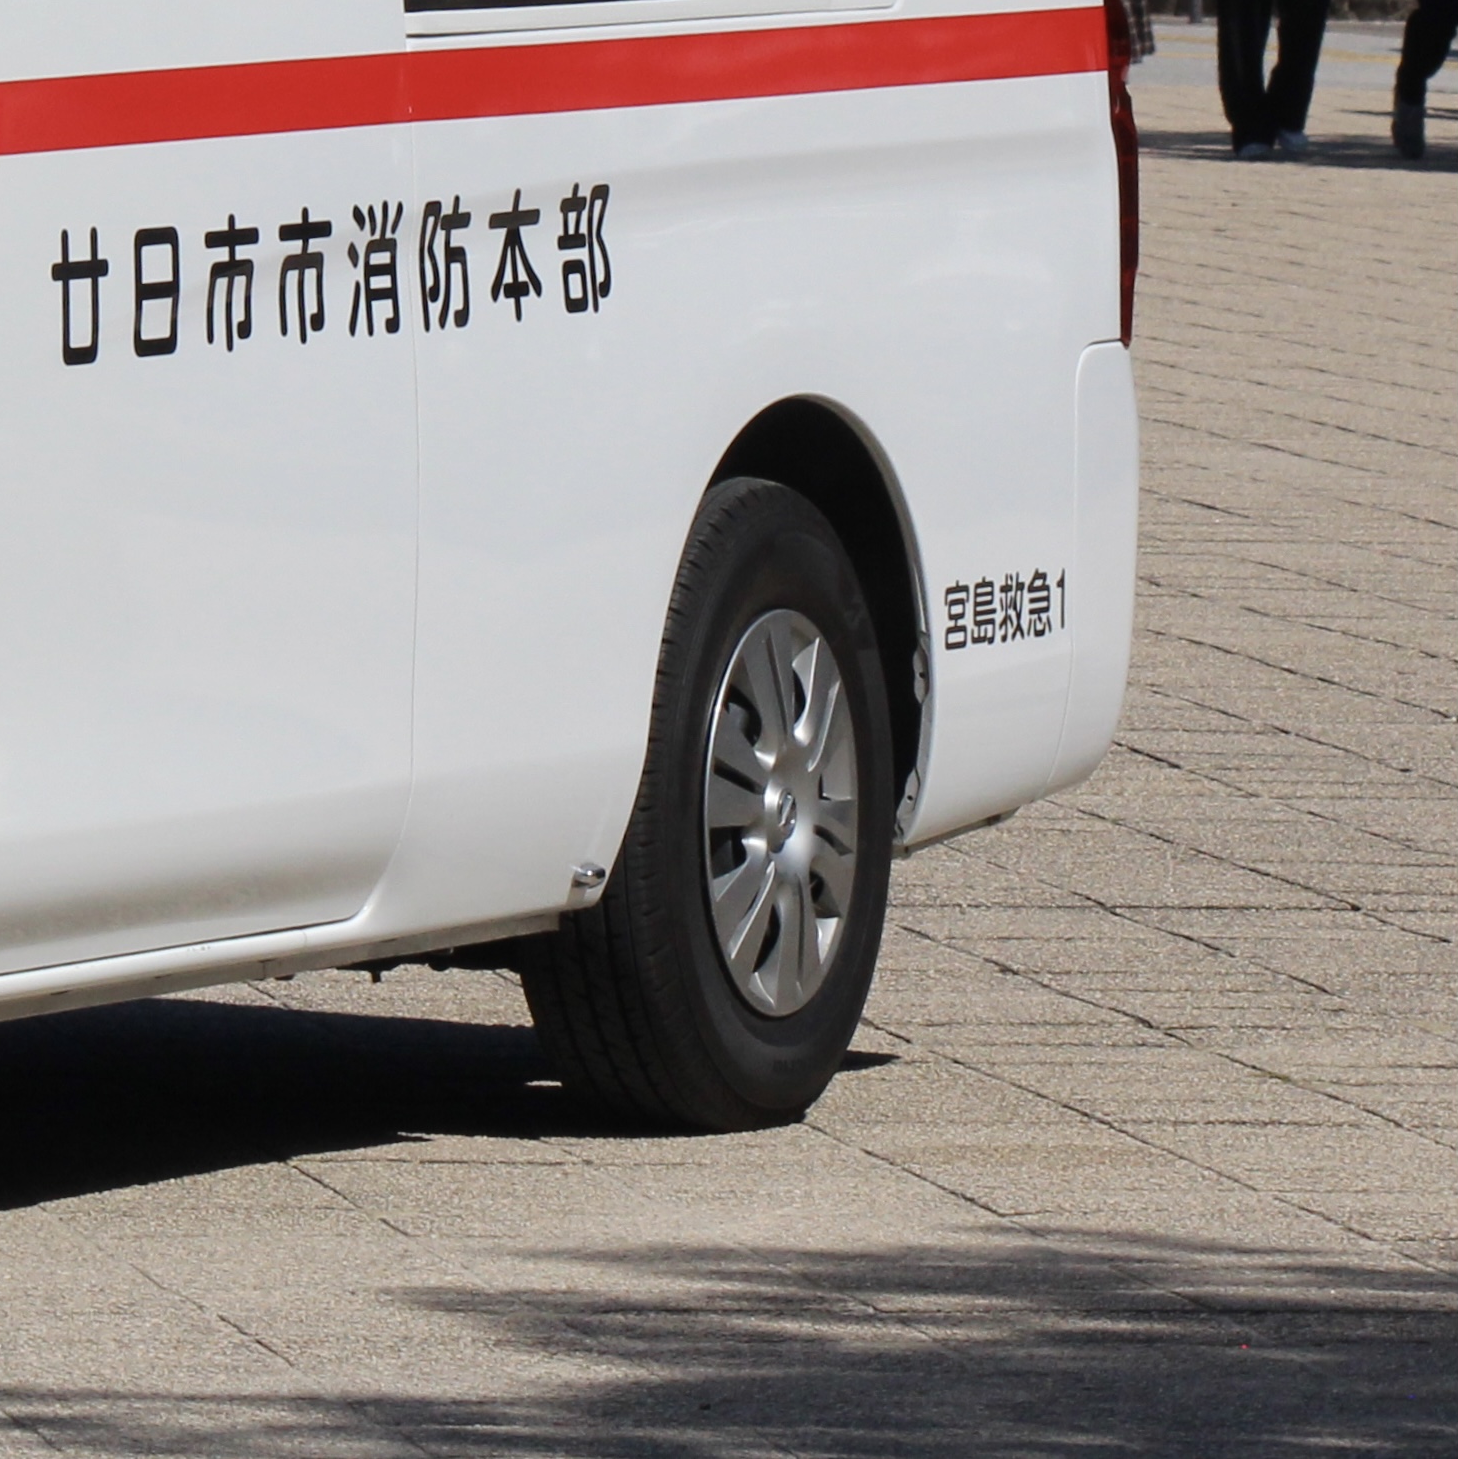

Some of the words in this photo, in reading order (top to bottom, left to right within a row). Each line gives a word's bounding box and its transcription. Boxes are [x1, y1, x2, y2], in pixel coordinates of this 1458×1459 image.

[51, 183, 611, 365] 廿日市市消防本部
[944, 568, 1066, 650] 宮島救急1
